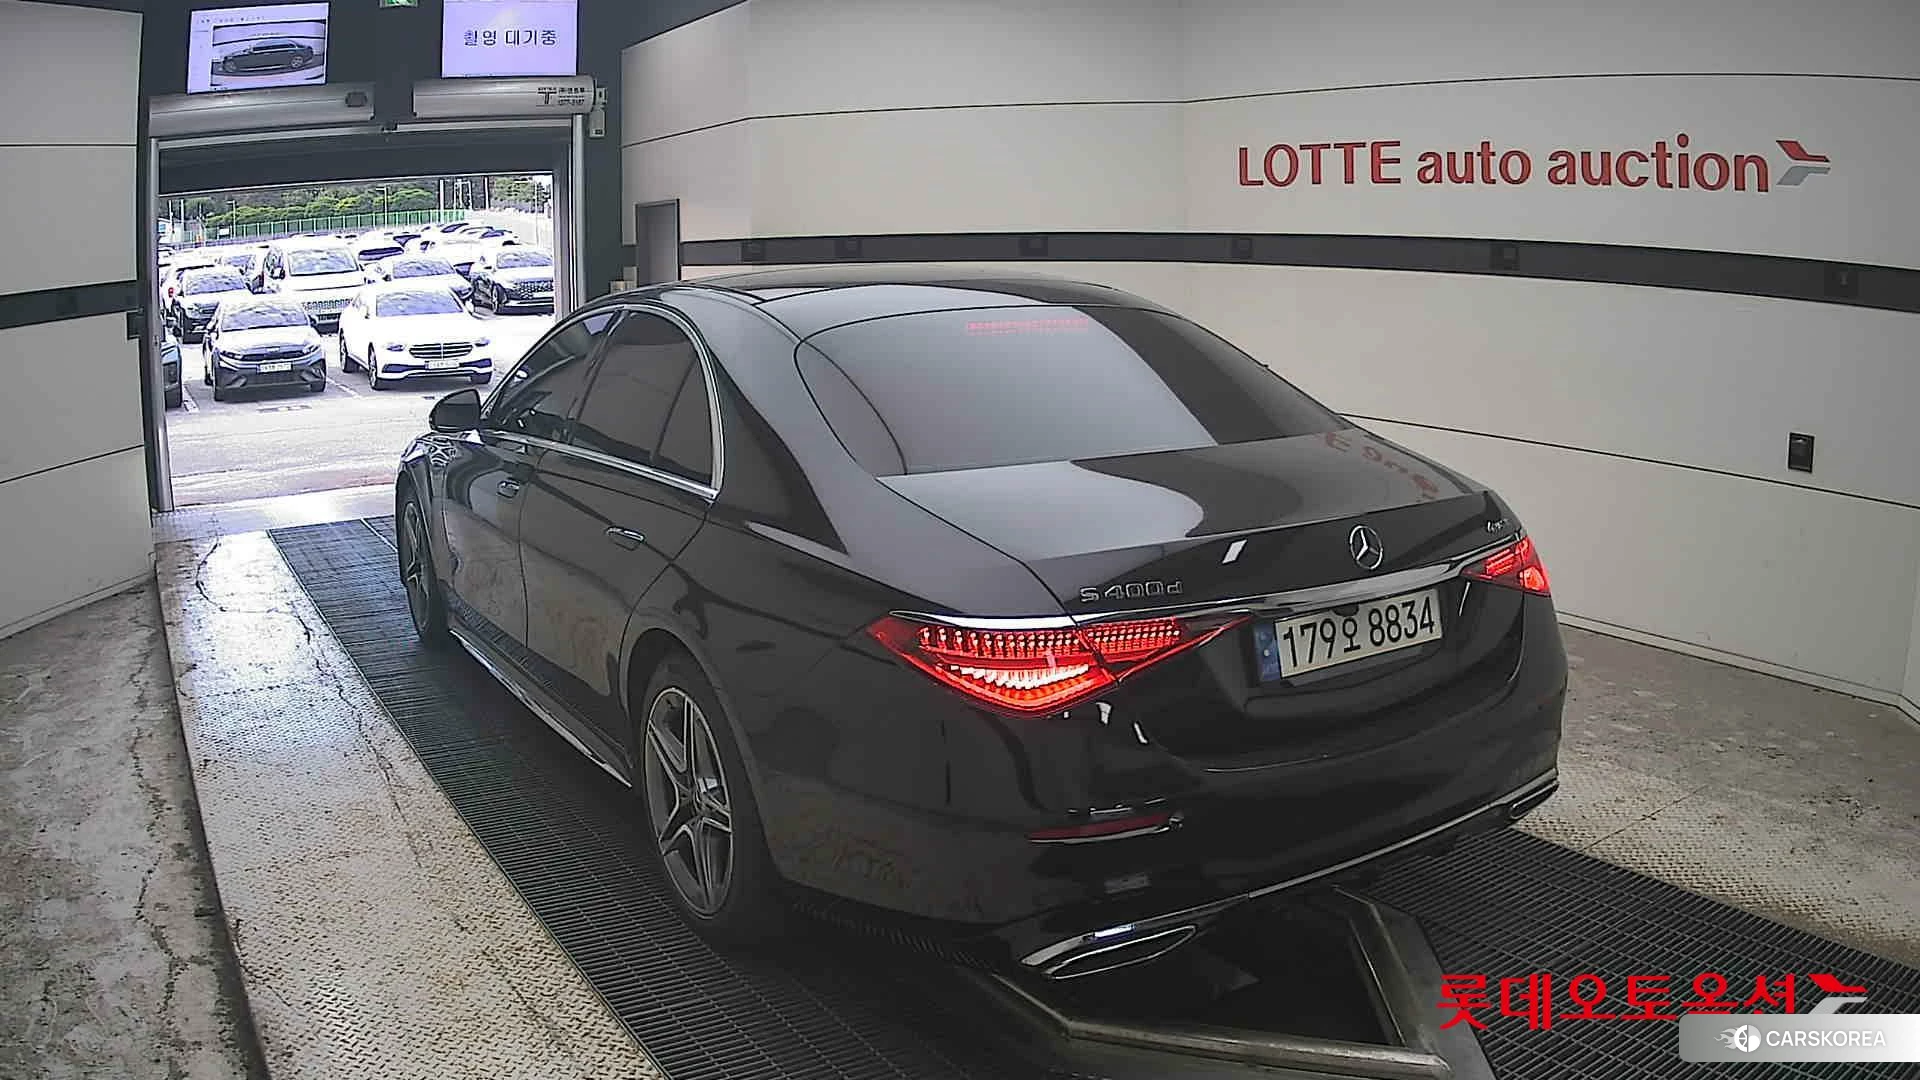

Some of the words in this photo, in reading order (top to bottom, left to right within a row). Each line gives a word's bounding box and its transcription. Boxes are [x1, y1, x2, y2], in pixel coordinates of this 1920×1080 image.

[505, 30, 556, 46] 대기중
[1239, 141, 1401, 187] LOTTE
[1417, 141, 1532, 186] auto
[1547, 133, 1769, 192] auction
[1368, 597, 1435, 647] 8834
